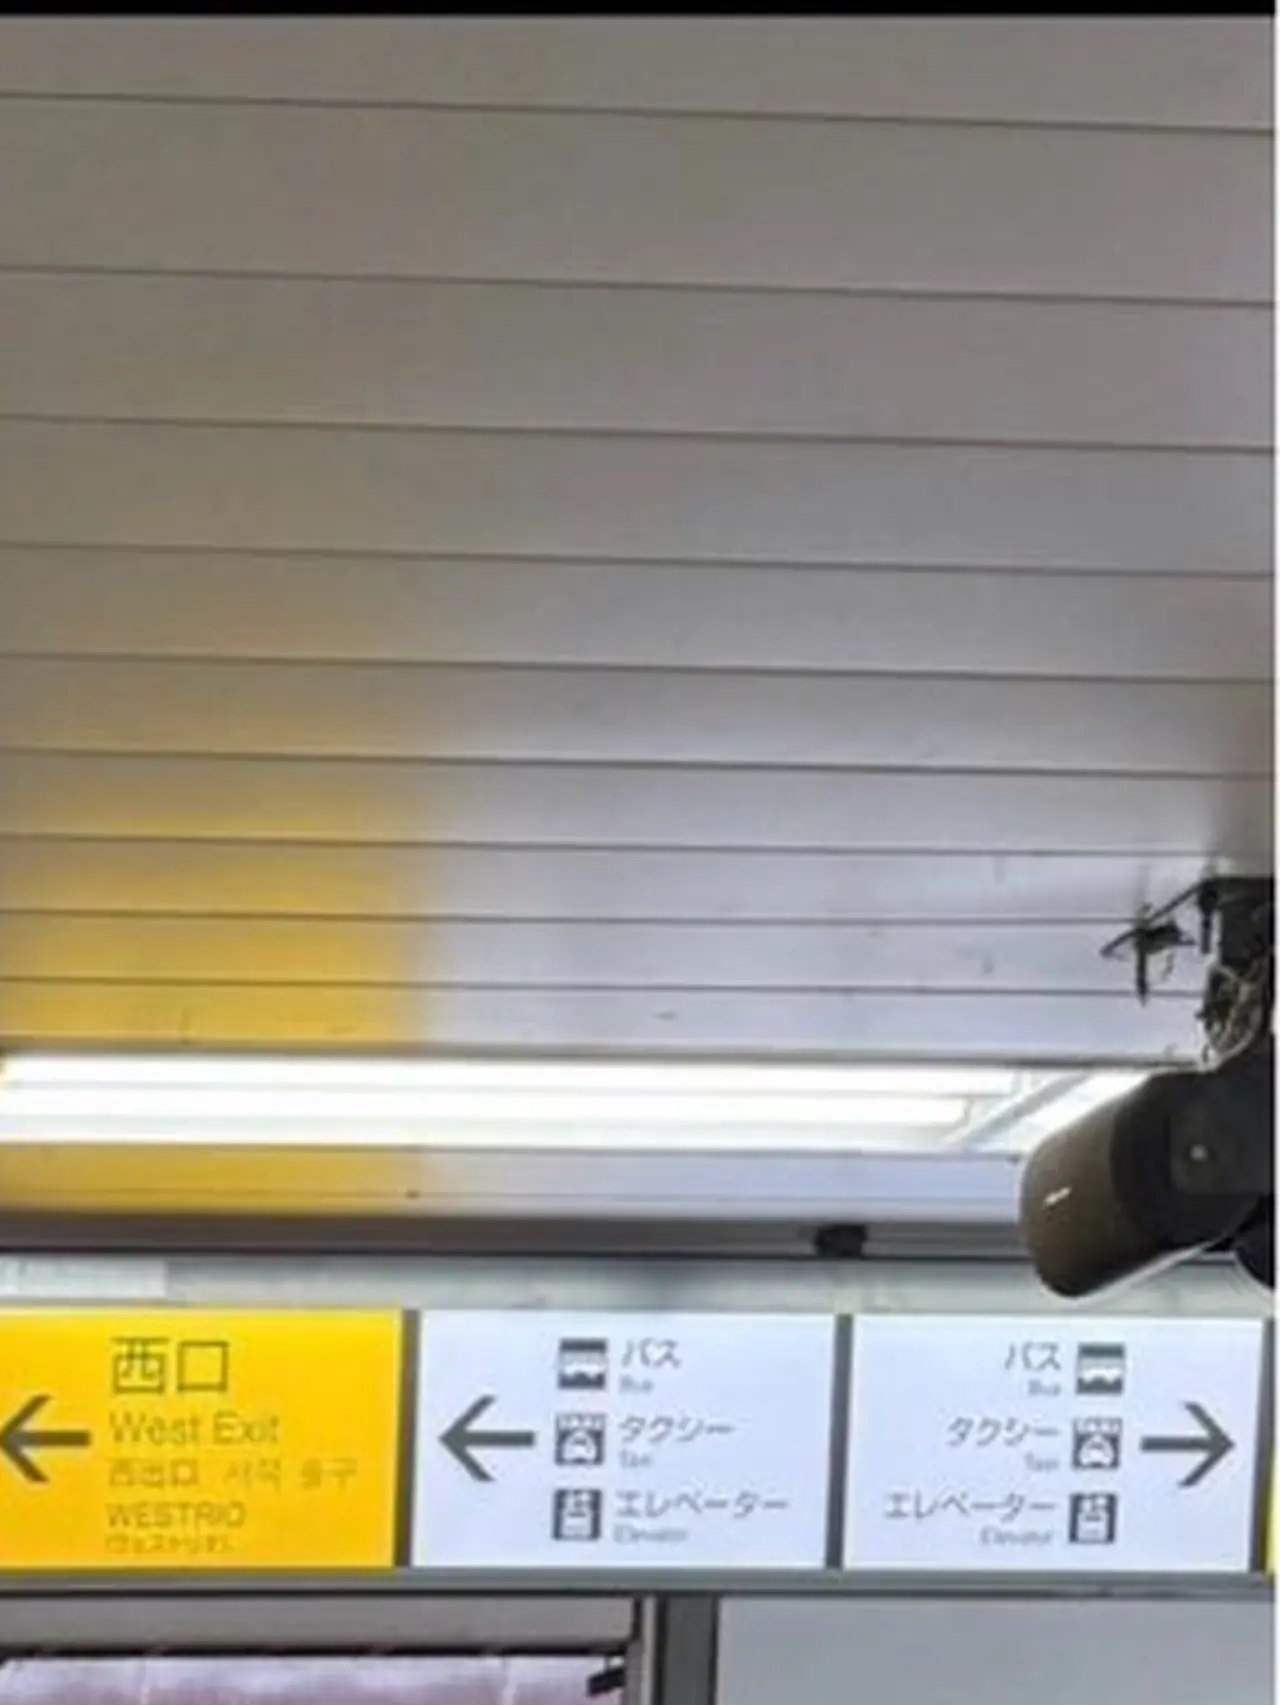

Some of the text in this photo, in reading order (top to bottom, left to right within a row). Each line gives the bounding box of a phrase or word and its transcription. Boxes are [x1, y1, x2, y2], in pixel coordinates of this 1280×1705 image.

[111, 1335, 230, 1395] 西口
[620, 1338, 683, 1369] バス
[1004, 1341, 1062, 1371] バス
[109, 1411, 280, 1445] West Exit
[618, 1414, 736, 1443] タクシー
[948, 1417, 1059, 1448] タクシー
[106, 1501, 247, 1530] WESTRIO
[616, 1489, 790, 1520] エレベーター
[883, 1492, 1058, 1522] エレベーター
